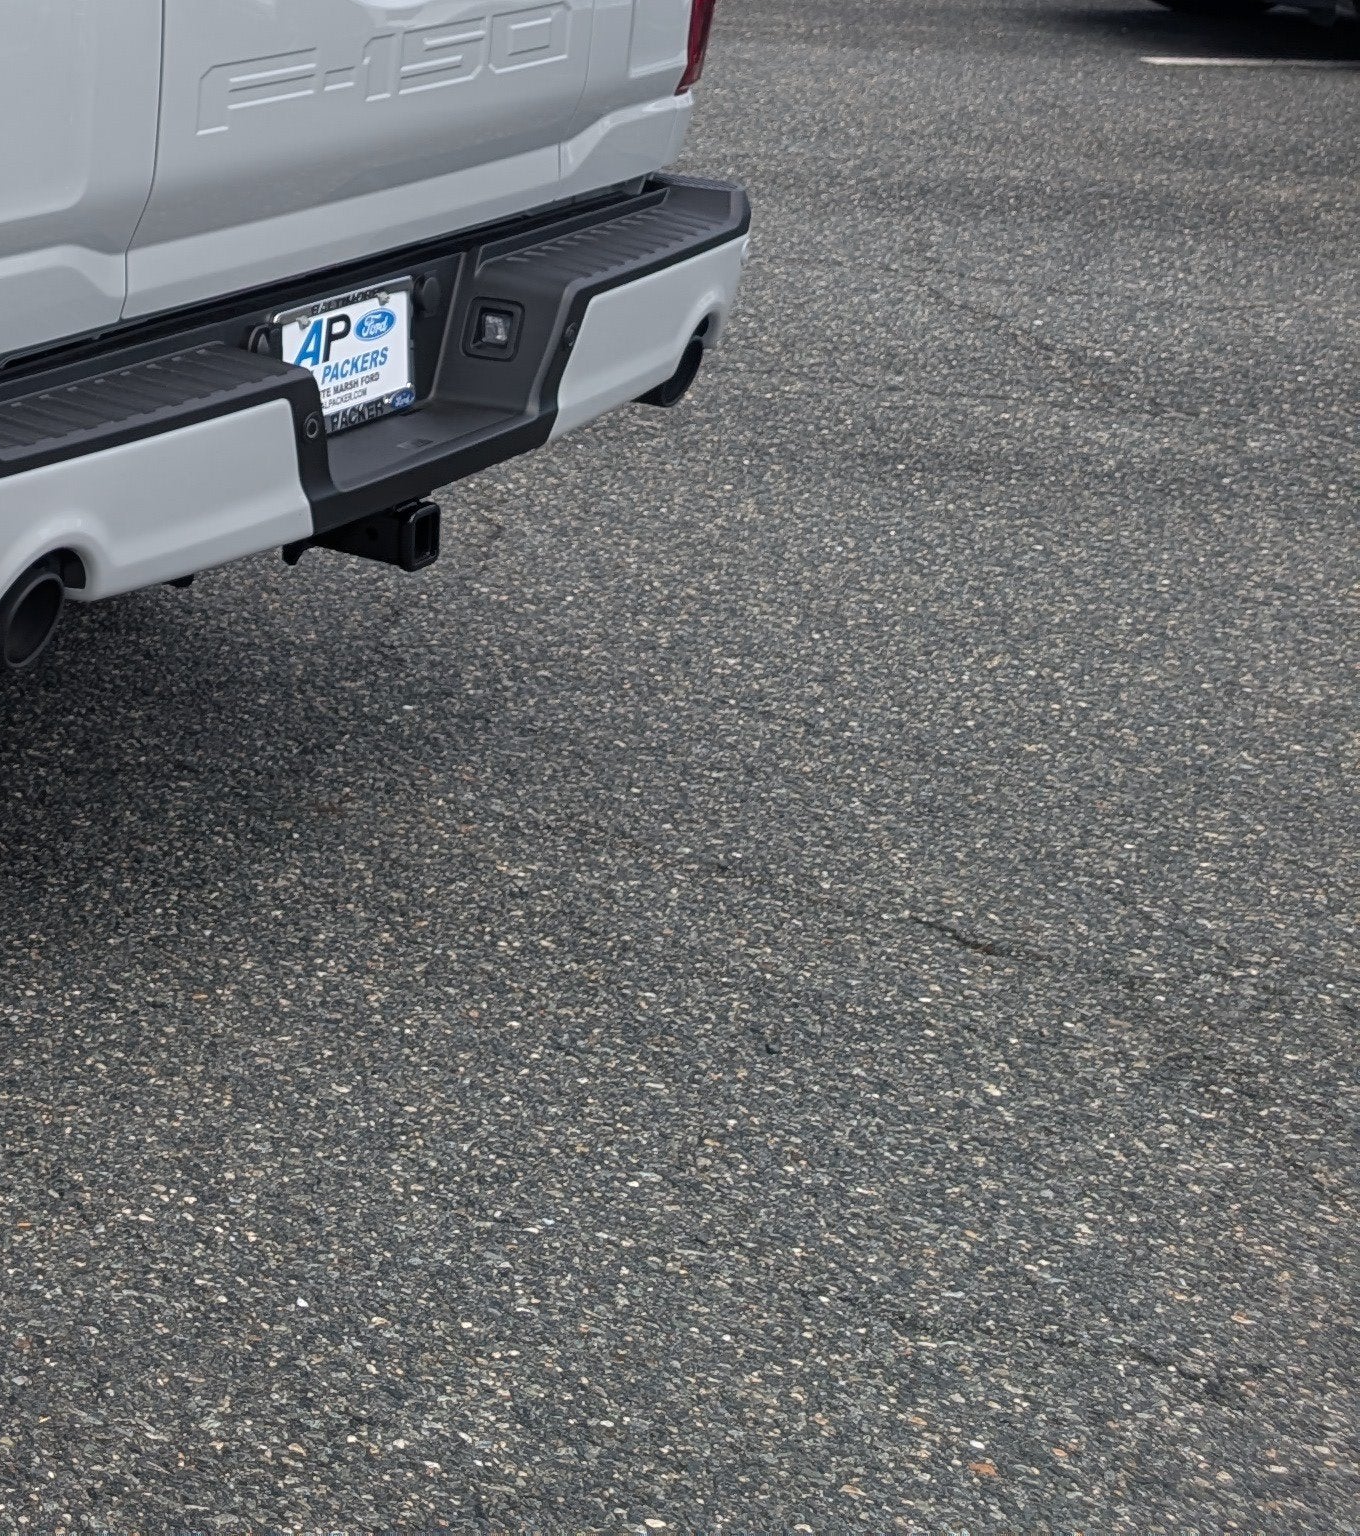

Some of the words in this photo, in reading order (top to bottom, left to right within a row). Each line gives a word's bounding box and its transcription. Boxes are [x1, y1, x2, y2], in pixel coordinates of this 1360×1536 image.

[196, 0, 573, 135] F-150
[293, 313, 351, 368] AP
[362, 313, 390, 337] Ford
[321, 346, 390, 385] PACKERS
[333, 378, 360, 395] MARSH
[361, 371, 381, 385] FORD
